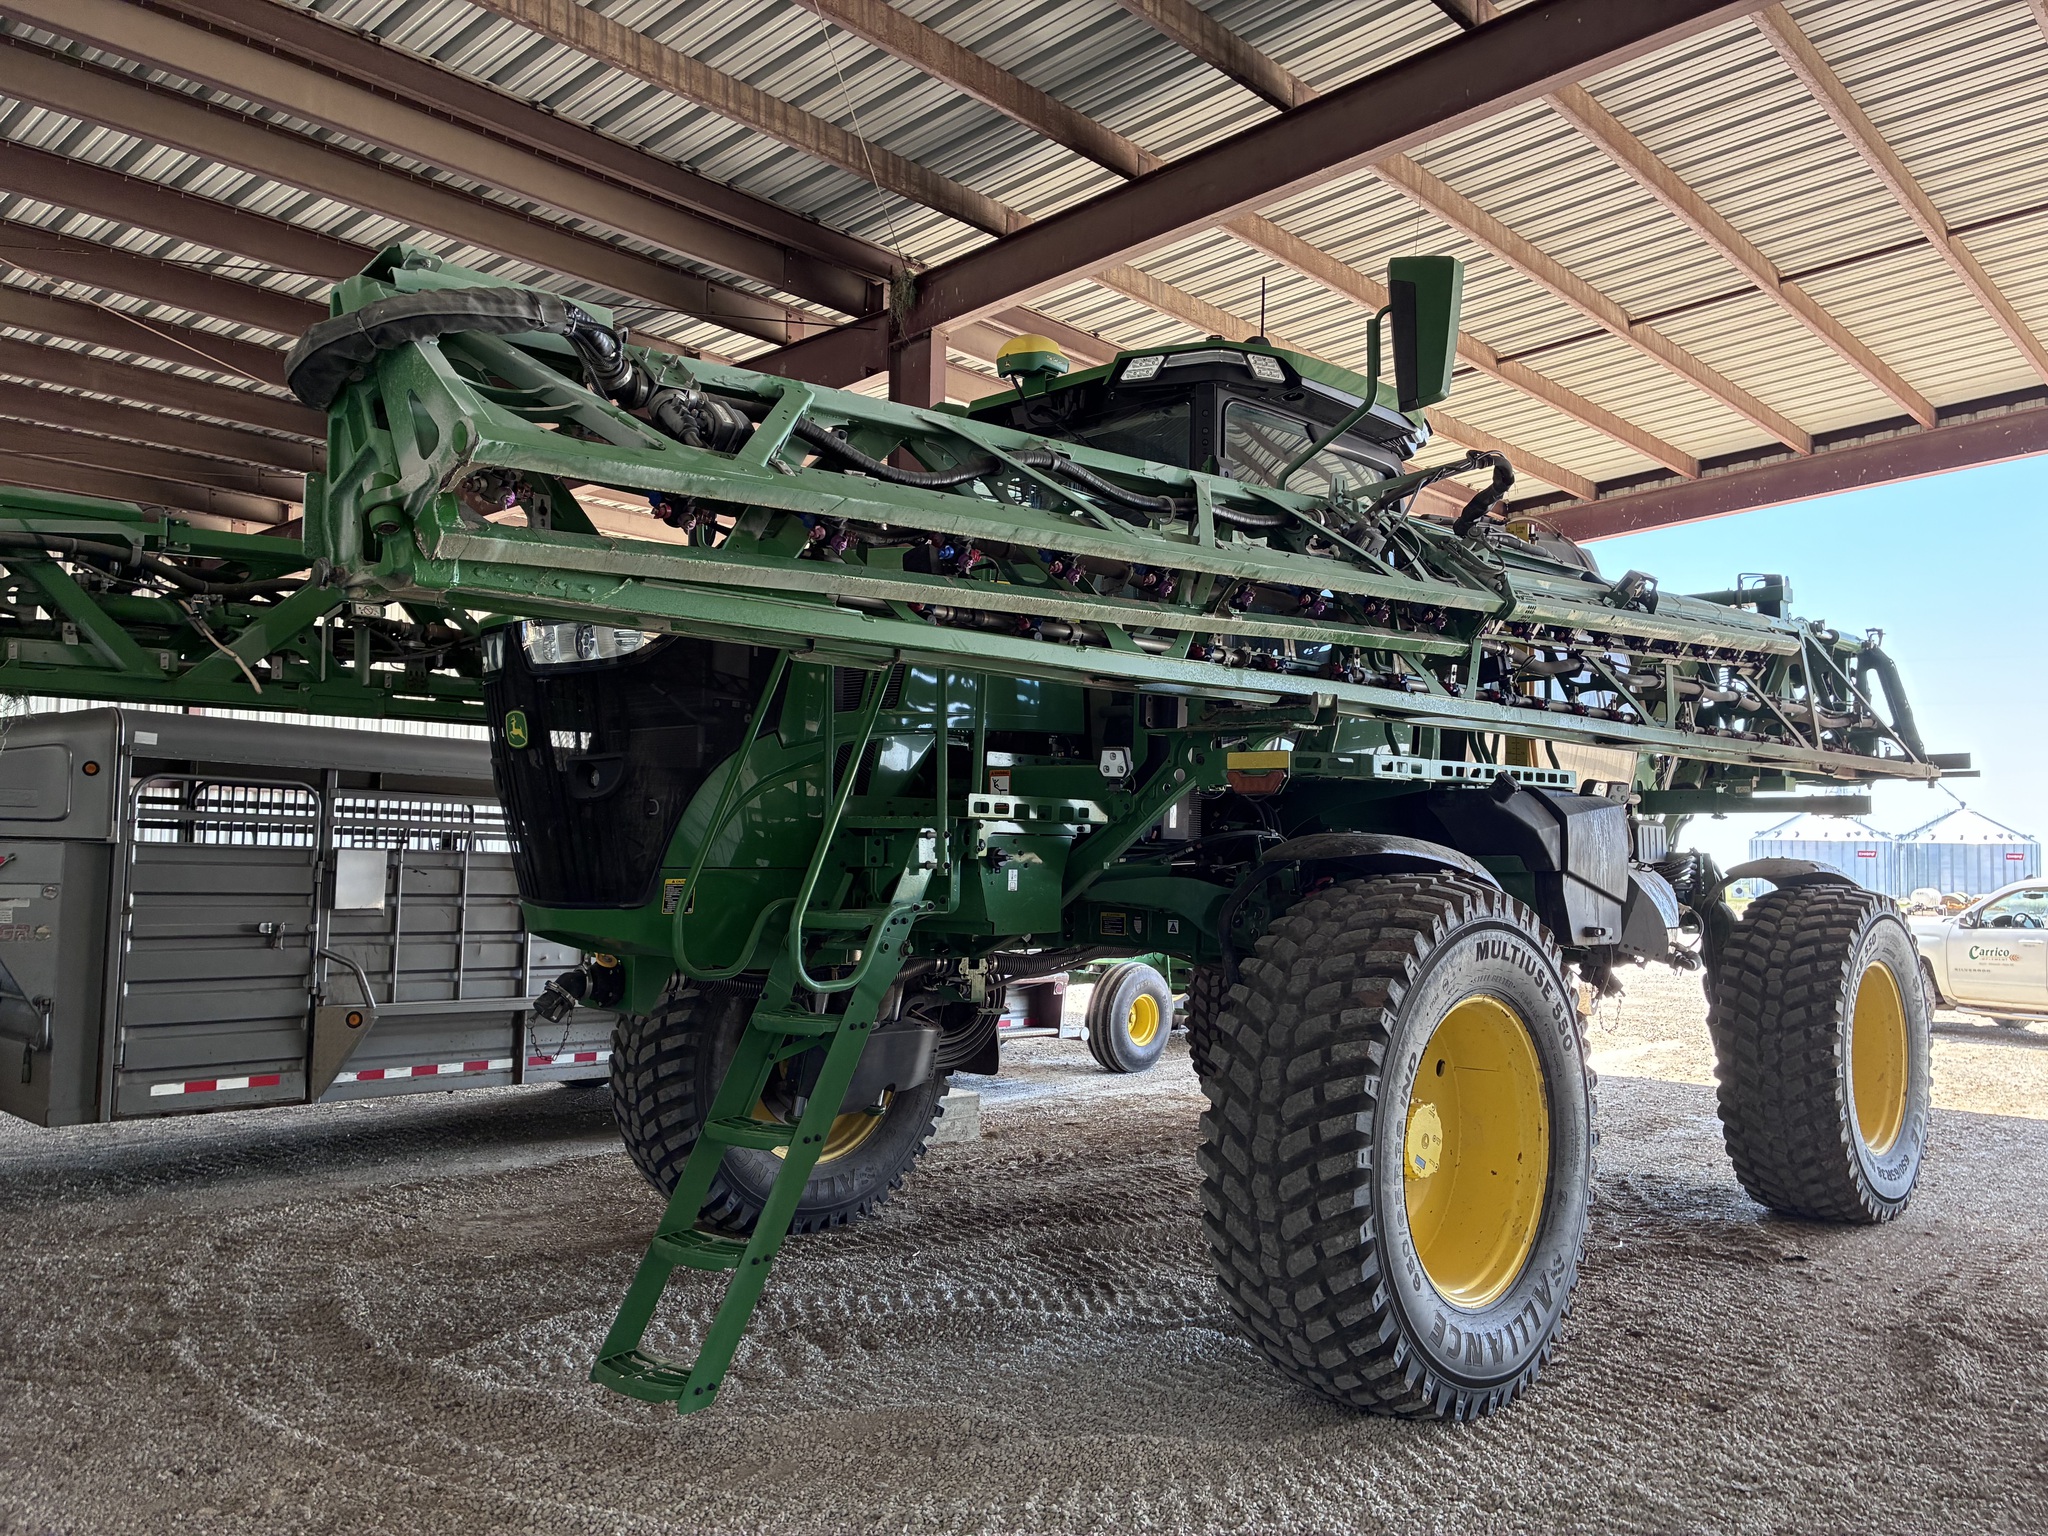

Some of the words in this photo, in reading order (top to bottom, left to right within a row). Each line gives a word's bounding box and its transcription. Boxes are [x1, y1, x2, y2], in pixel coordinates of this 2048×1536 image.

[1864, 932, 1877, 958] 550
[1969, 945, 2010, 960] Carrico
[1475, 940, 1554, 1002] MULTIUSE
[1552, 1003, 1573, 1052] 550
[1399, 1051, 1417, 1110] IND
[1428, 1270, 1553, 1367] ALLIANCE
